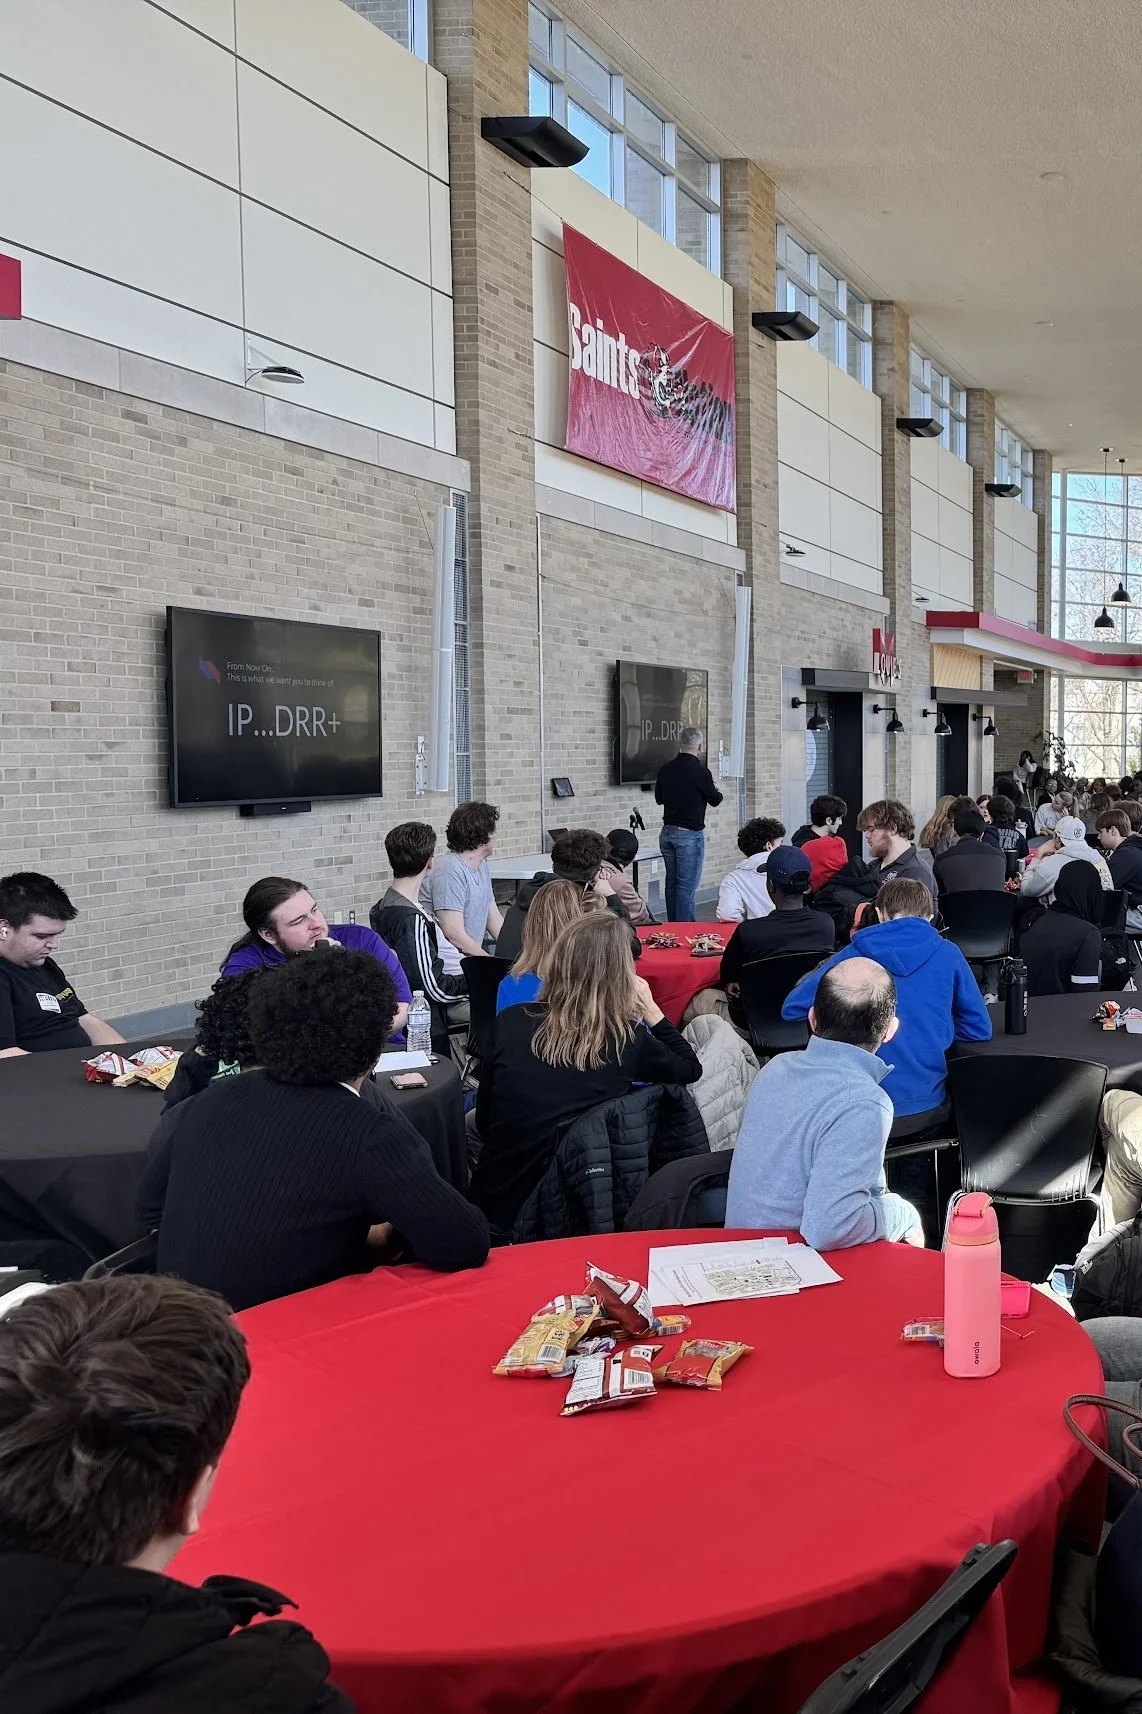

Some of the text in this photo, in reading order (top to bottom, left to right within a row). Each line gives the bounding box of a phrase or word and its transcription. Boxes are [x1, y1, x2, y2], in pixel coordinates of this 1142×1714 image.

[569, 302, 641, 400] Saints
[226, 661, 245, 671] From
[246, 663, 261, 672] Now
[226, 673, 241, 682] This
[241, 674, 247, 682] is
[248, 674, 264, 684] what
[275, 677, 291, 685] want
[291, 678, 304, 686] you
[311, 679, 326, 687] think
[228, 703, 341, 737] IP...DRR+
